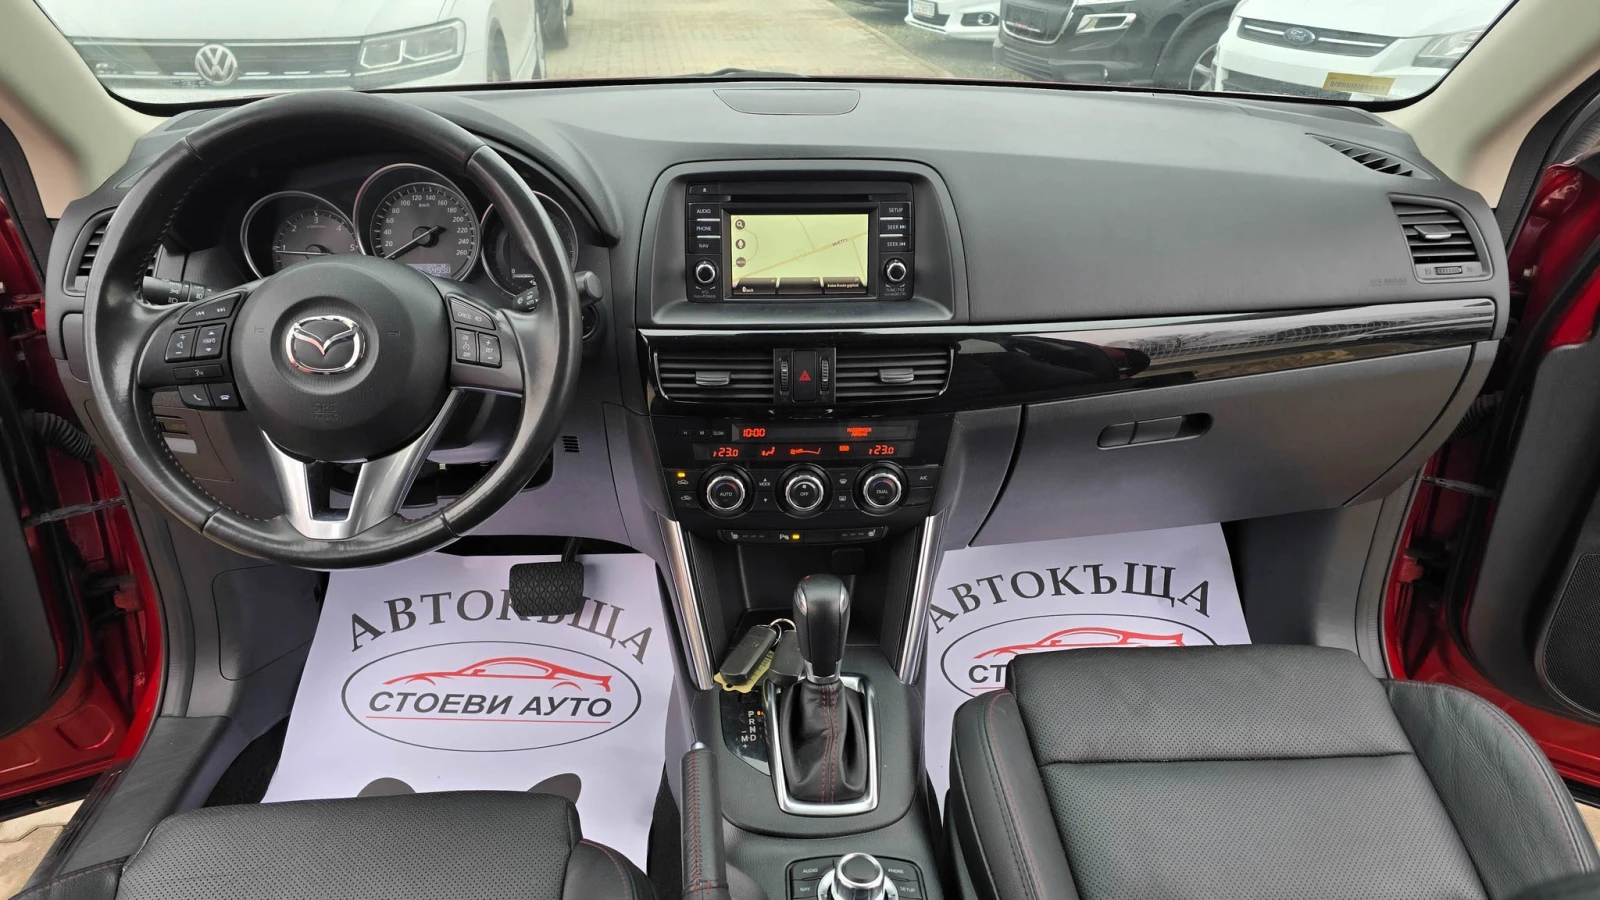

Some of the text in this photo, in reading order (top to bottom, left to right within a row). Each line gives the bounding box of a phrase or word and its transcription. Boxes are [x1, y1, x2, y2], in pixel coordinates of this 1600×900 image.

[313, 403, 337, 412] SRS
[743, 428, 765, 437] 10:00
[928, 562, 1210, 634] АВТОКЪЩА
[351, 589, 653, 664] АВТОКЩА
[369, 691, 612, 717] СТОЕВИ АУТО
